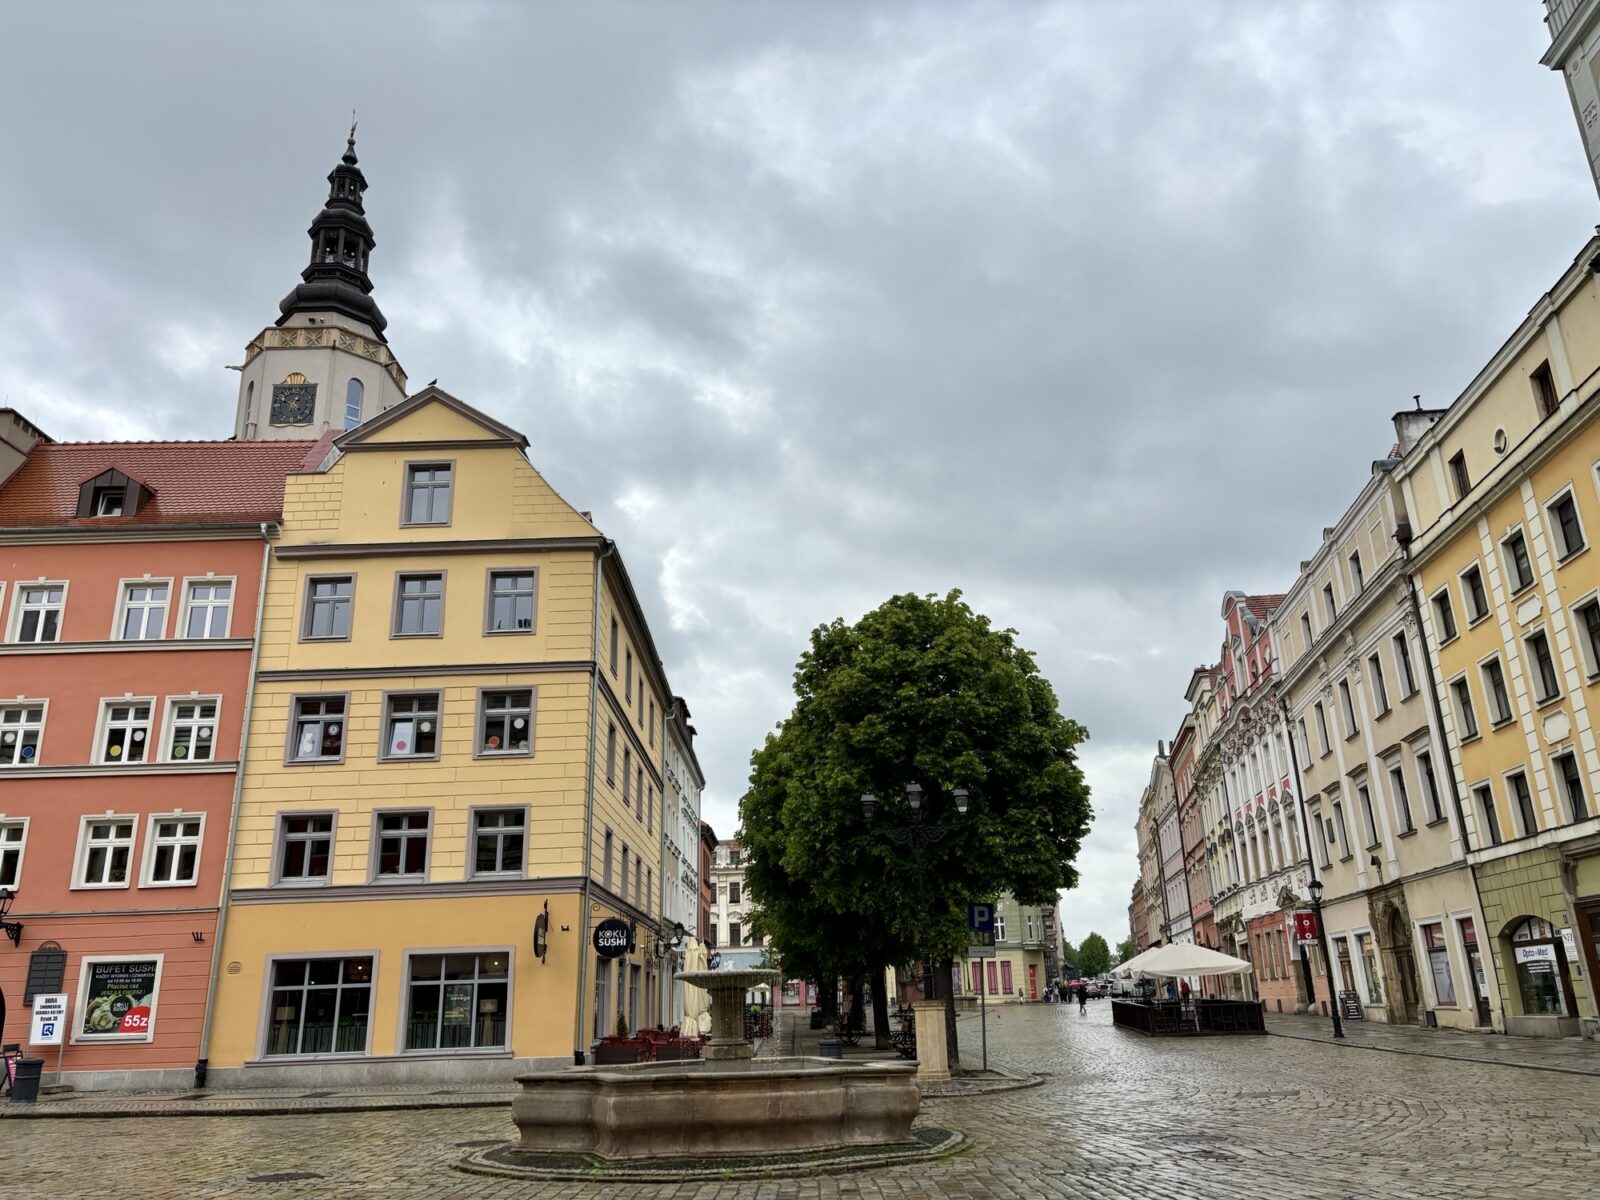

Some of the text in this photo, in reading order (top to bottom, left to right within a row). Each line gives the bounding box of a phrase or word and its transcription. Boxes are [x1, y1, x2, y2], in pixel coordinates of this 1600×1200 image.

[974, 906, 988, 928] P
[598, 930, 626, 938] KOKU
[598, 938, 626, 946] SUSHI
[96, 965, 127, 973] BUFET
[124, 1015, 150, 1027] 55z
